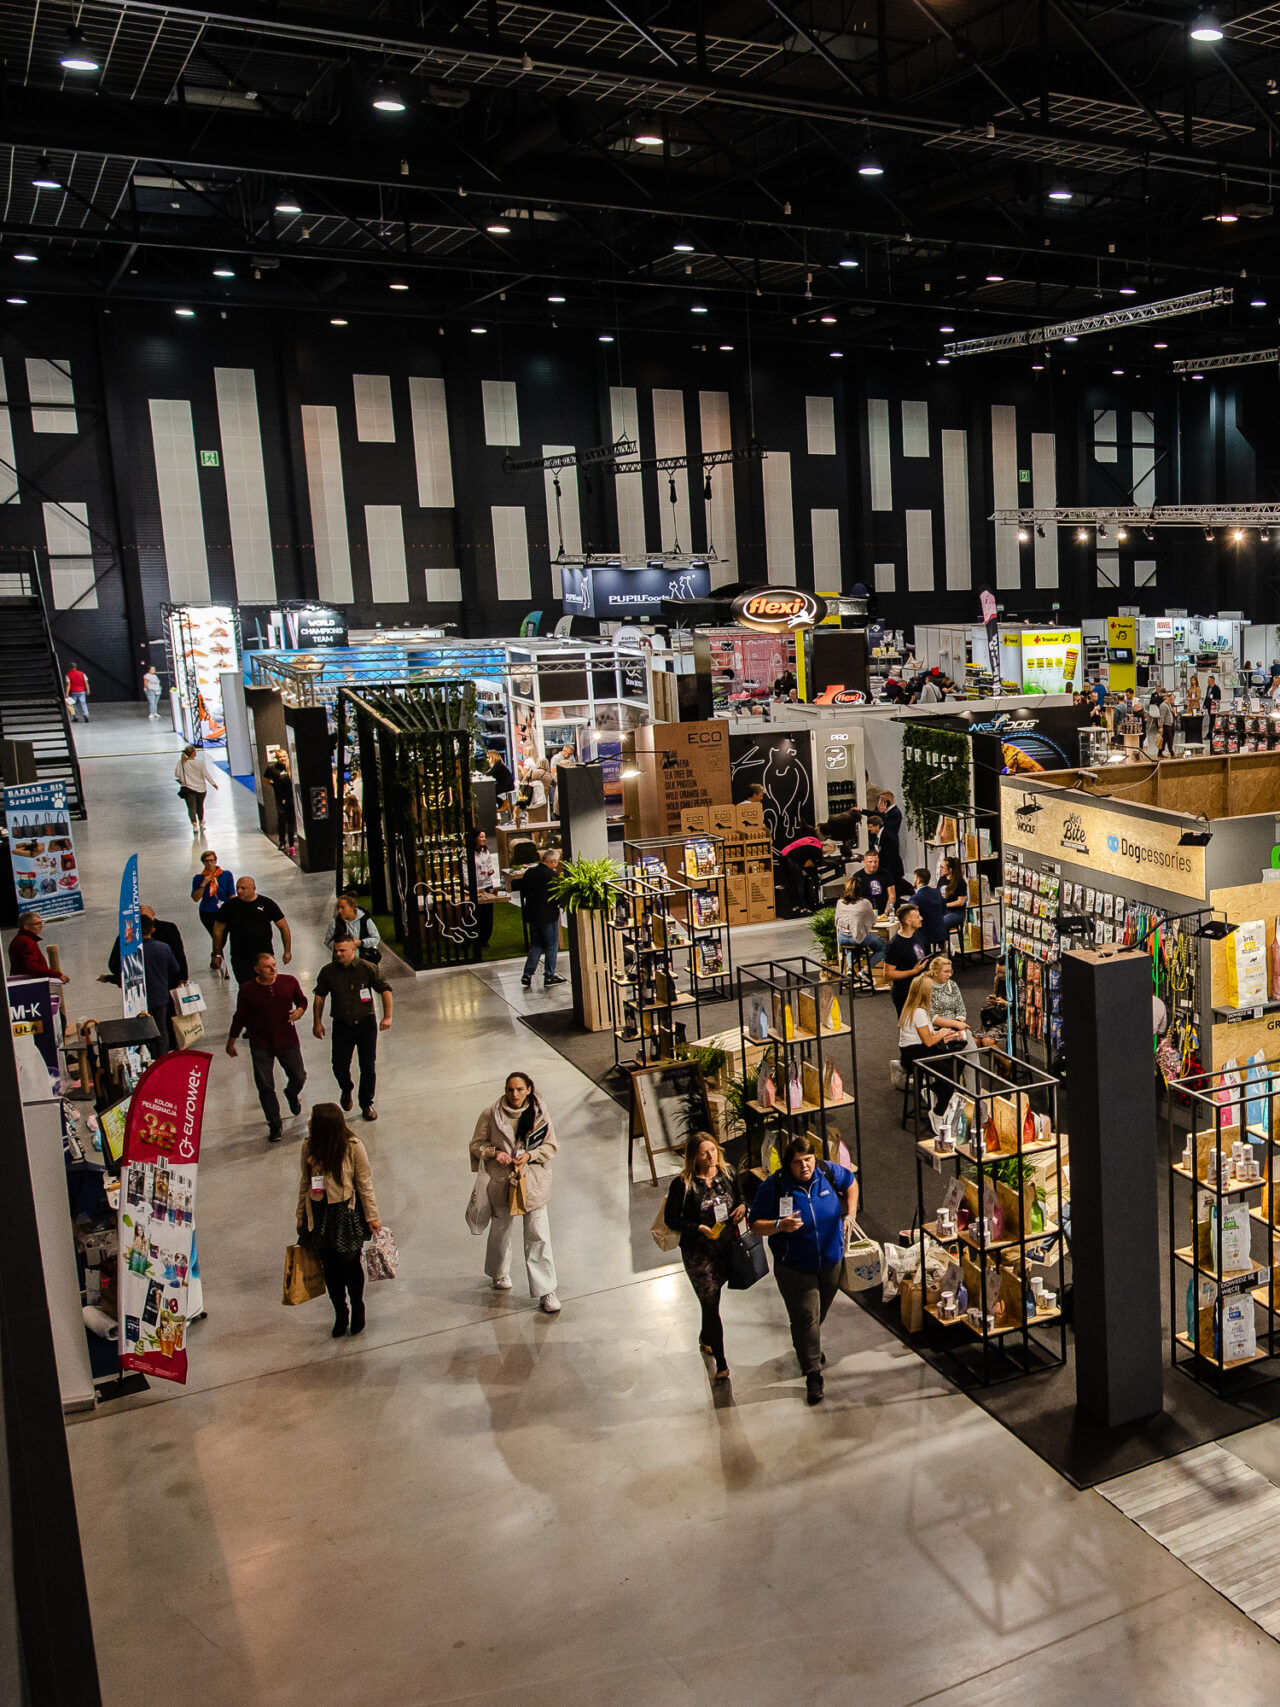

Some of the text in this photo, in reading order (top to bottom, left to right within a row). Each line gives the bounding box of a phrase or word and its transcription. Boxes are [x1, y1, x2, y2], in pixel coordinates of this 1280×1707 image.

[609, 594, 670, 603] PUPILFoods
[748, 598, 802, 615] flexi
[301, 627, 343, 635] CHAMPIONS
[837, 693, 860, 701] flexi
[688, 731, 722, 744] ECO
[830, 733, 848, 741] PRO
[7, 786, 42, 798] BAZKAR
[49, 783, 63, 791] BIS
[9, 795, 49, 806] Szwalnia
[1063, 820, 1086, 843] Bite
[1121, 838, 1192, 873] Dogcessories
[141, 1100, 177, 1117] PELĘGNACJA
[154, 1098, 173, 1108] KOLOR
